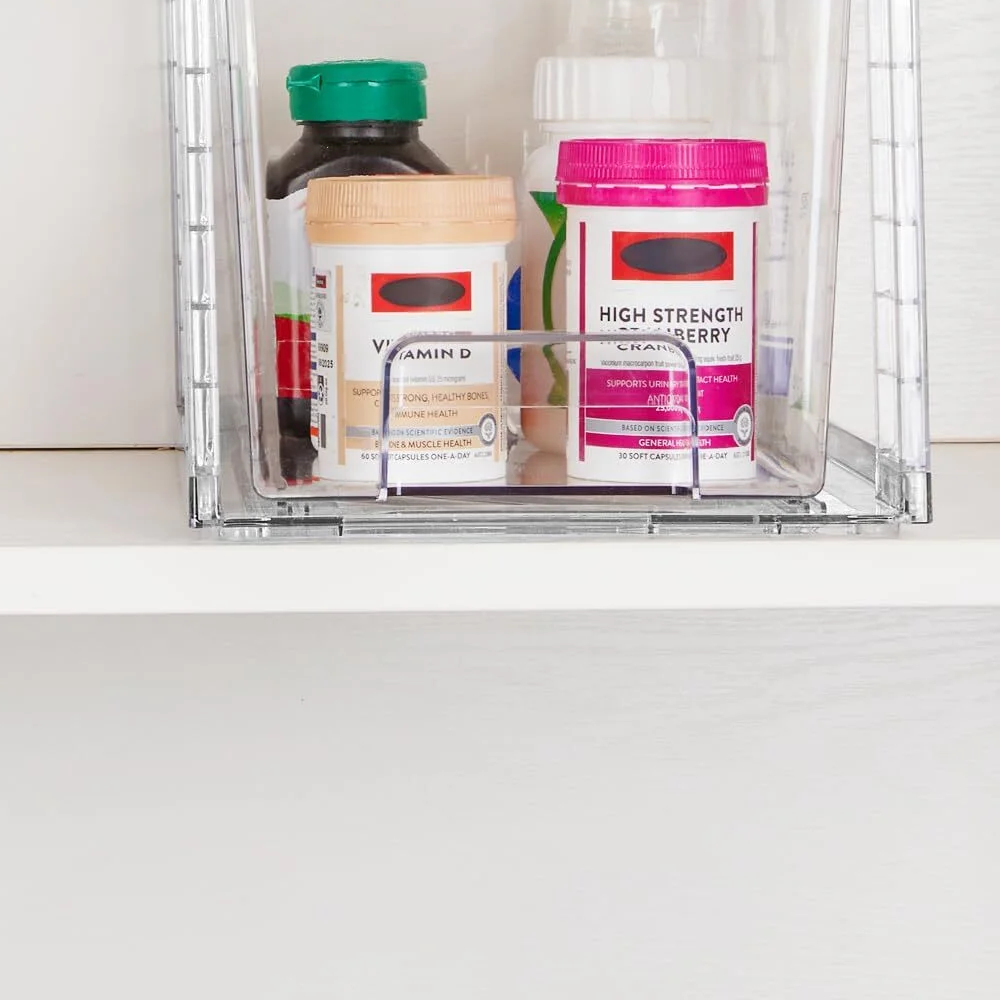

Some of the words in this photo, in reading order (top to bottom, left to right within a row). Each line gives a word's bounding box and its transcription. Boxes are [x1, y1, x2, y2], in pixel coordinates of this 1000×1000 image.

[600, 306, 646, 323] HIGH
[653, 306, 743, 323] STRENGTH
[460, 348, 472, 359] D
[607, 380, 647, 388] SUPPORTS
[714, 375, 738, 383] HEALTH
[432, 393, 465, 401] HEALTHY
[427, 409, 458, 418] HEALTH
[444, 427, 473, 436] EVIDENCE
[621, 424, 642, 432] BASED
[645, 424, 655, 432] ON
[400, 440, 406, 448] &
[408, 440, 441, 448] MUSCLE
[443, 439, 472, 447] HEALTH
[638, 438, 674, 447] GENERAL
[395, 453, 432, 461] CAPSULES
[434, 451, 471, 460] ONE-A-DAY
[629, 452, 648, 460] SOFT
